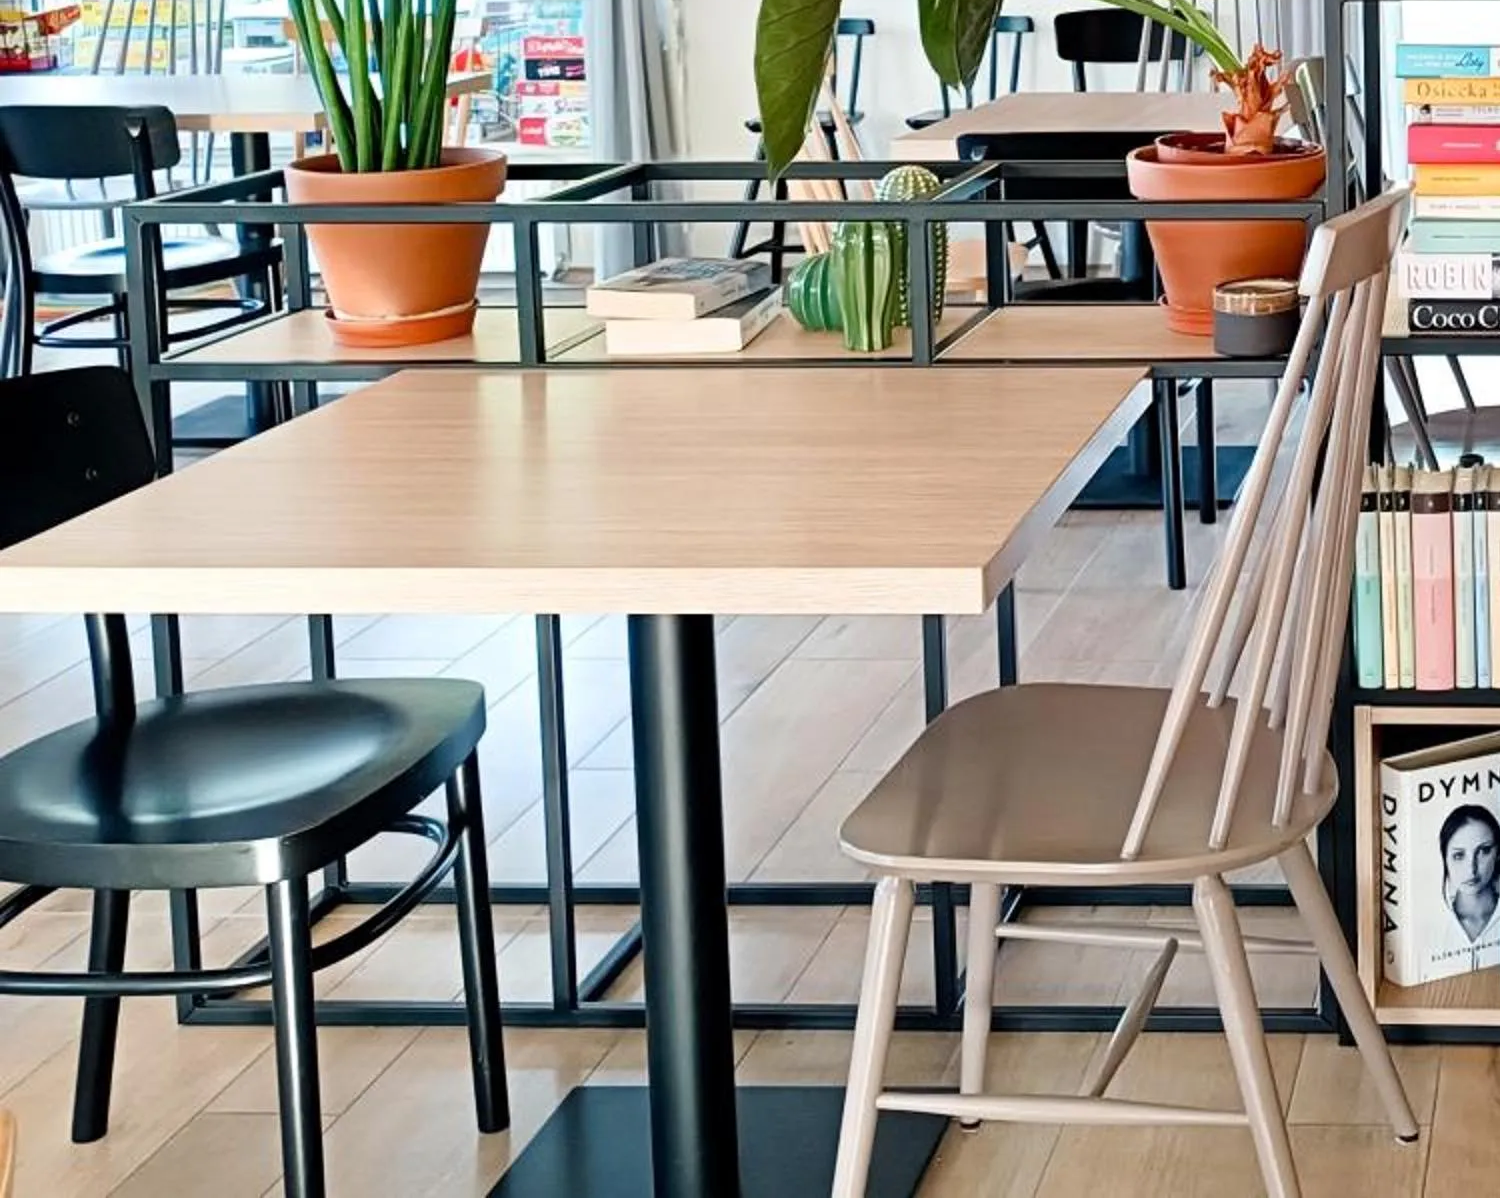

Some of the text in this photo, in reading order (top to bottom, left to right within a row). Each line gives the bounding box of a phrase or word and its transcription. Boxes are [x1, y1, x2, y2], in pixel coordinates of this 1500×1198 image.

[1455, 51, 1485, 71] Listy
[1415, 81, 1488, 99] Osiecka
[1405, 262, 1487, 292] ROBIN
[1412, 306, 1475, 330] Coco
[1382, 794, 1399, 934] DYMNA
